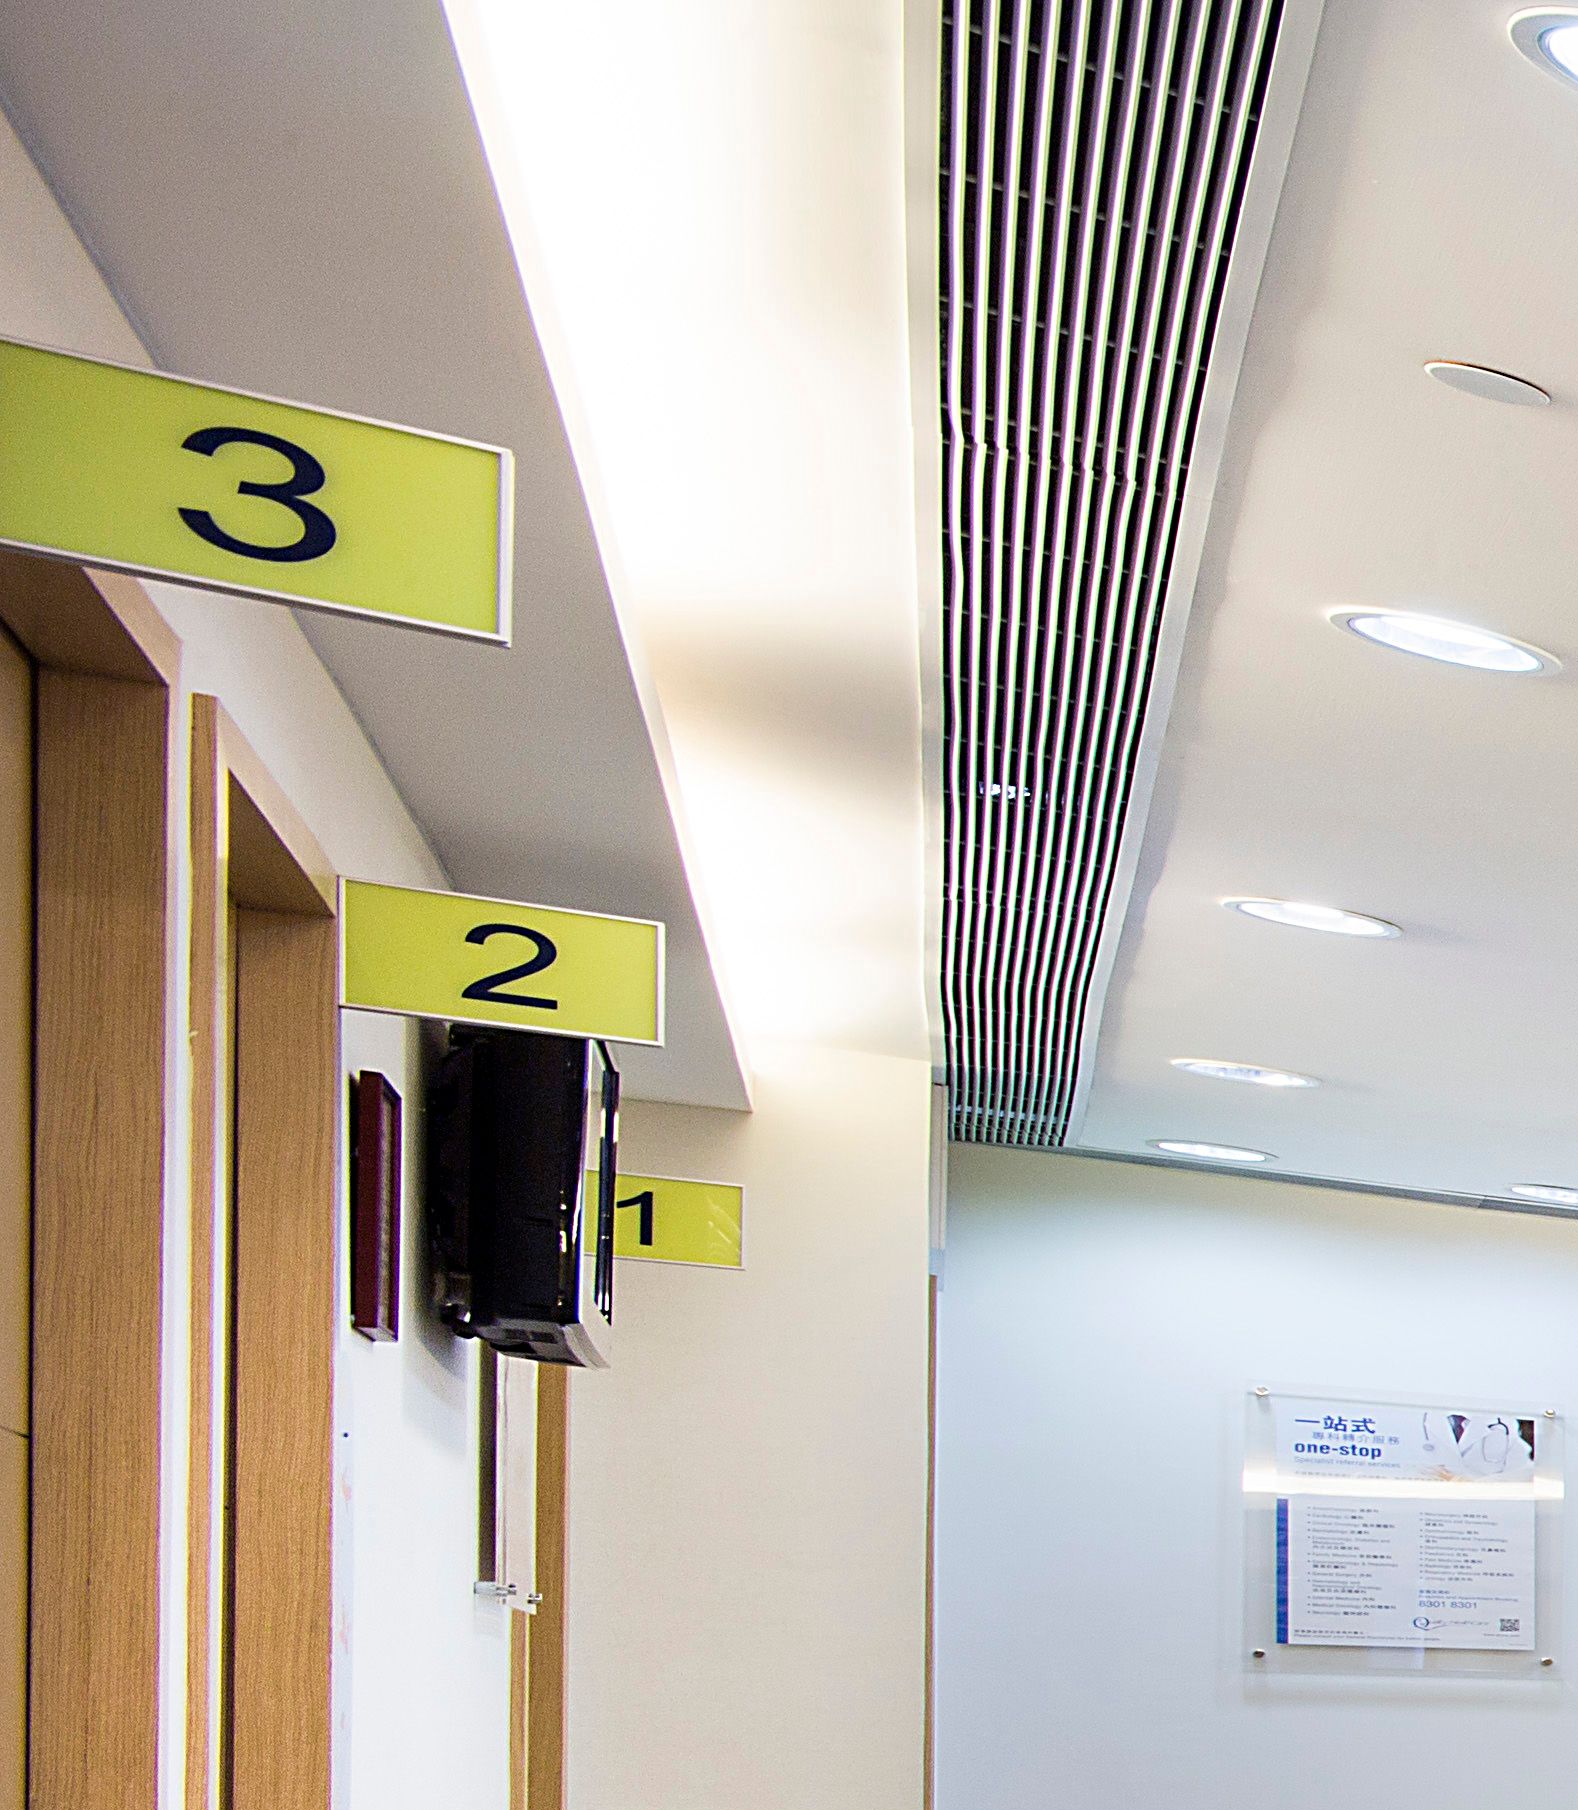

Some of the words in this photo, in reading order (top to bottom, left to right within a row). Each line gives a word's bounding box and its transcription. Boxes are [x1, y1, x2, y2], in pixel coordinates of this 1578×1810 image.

[177, 426, 338, 562] 3
[460, 922, 559, 1010] 2
[616, 1190, 654, 1246] 1
[1294, 1415, 1376, 1435] 一站式
[1294, 1441, 1383, 1461] one-stop
